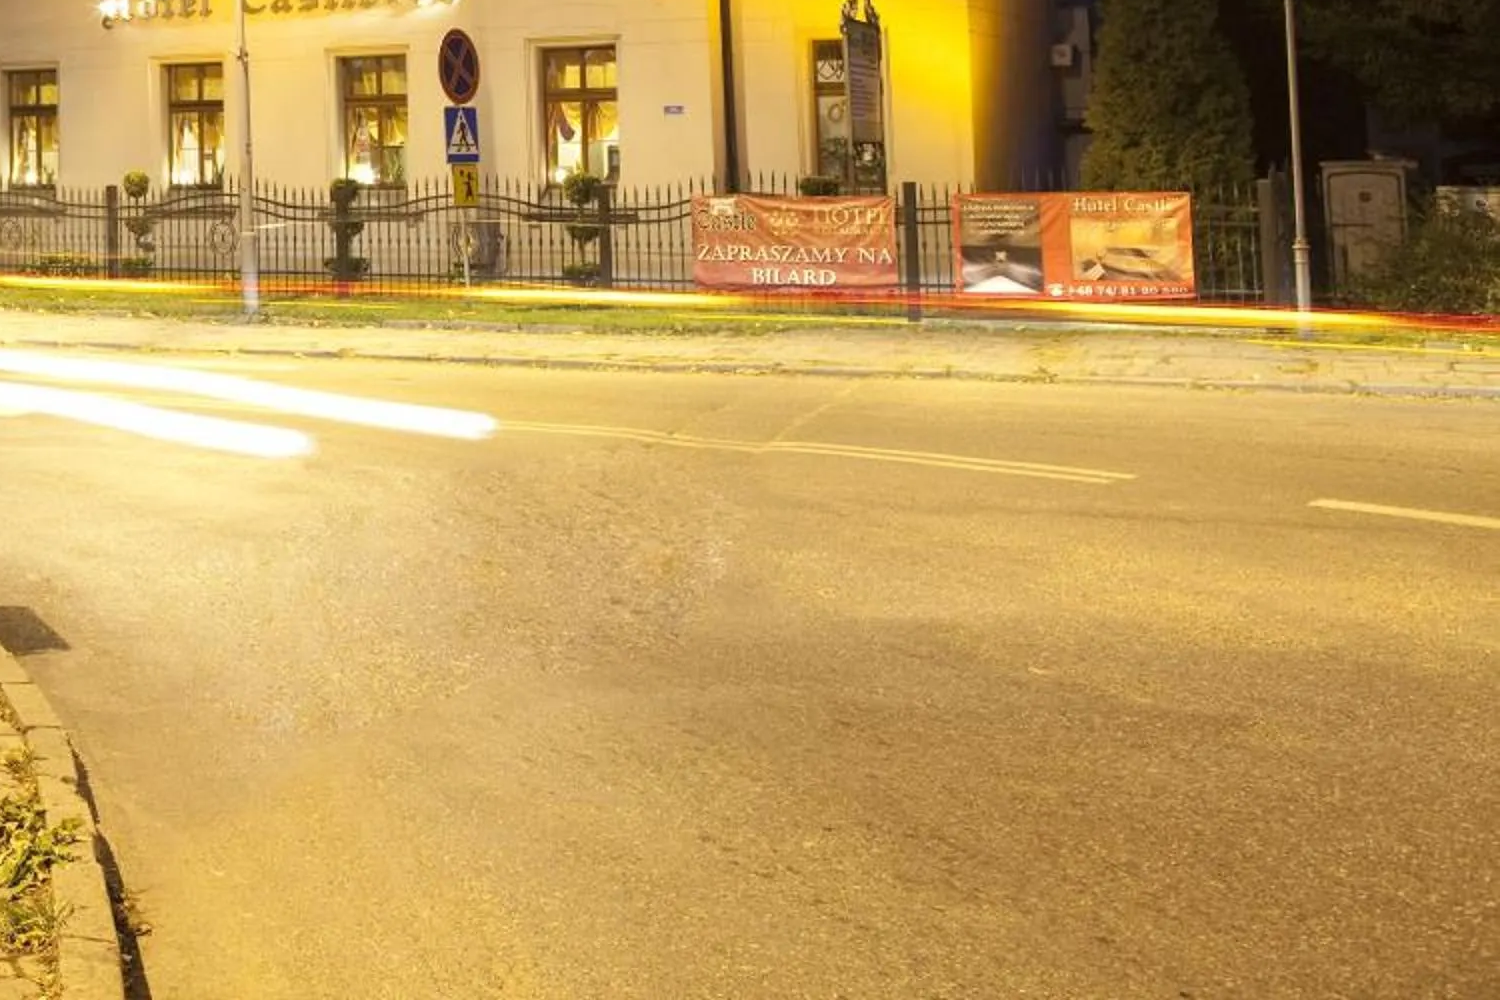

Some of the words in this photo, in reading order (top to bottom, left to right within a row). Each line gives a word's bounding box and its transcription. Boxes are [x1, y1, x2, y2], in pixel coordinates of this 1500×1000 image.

[698, 209, 757, 232] Castle
[697, 245, 849, 264] ZAPRASZAMY
[856, 246, 893, 264] NA
[751, 267, 838, 285] BILARD
